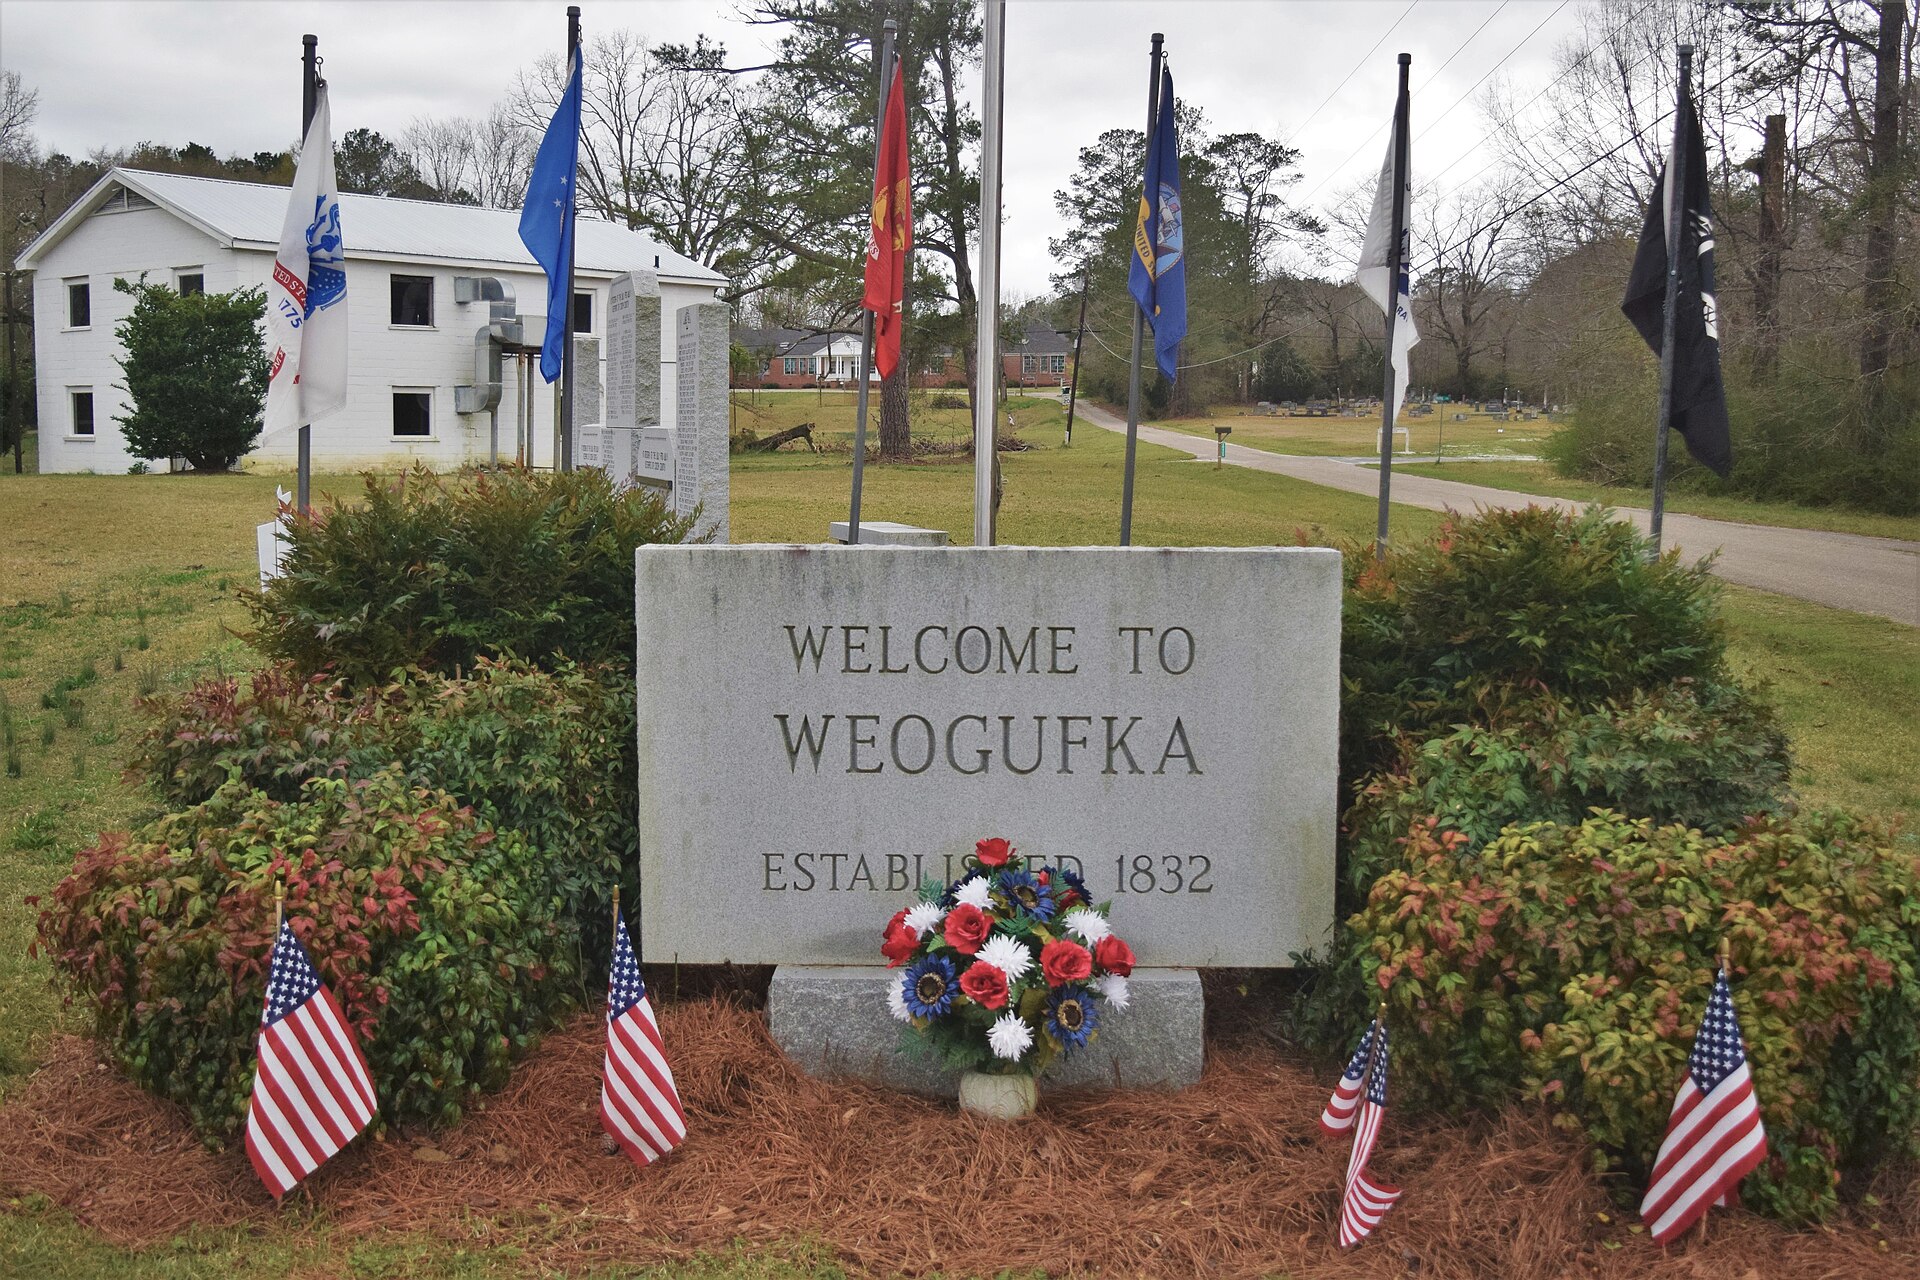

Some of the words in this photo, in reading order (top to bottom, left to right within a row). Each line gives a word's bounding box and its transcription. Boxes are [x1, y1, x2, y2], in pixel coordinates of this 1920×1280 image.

[783, 625, 1079, 675] WELCOME
[1118, 625, 1196, 675] TO
[774, 714, 1204, 776] WEOGUFKA
[1115, 853, 1214, 894] 1832
